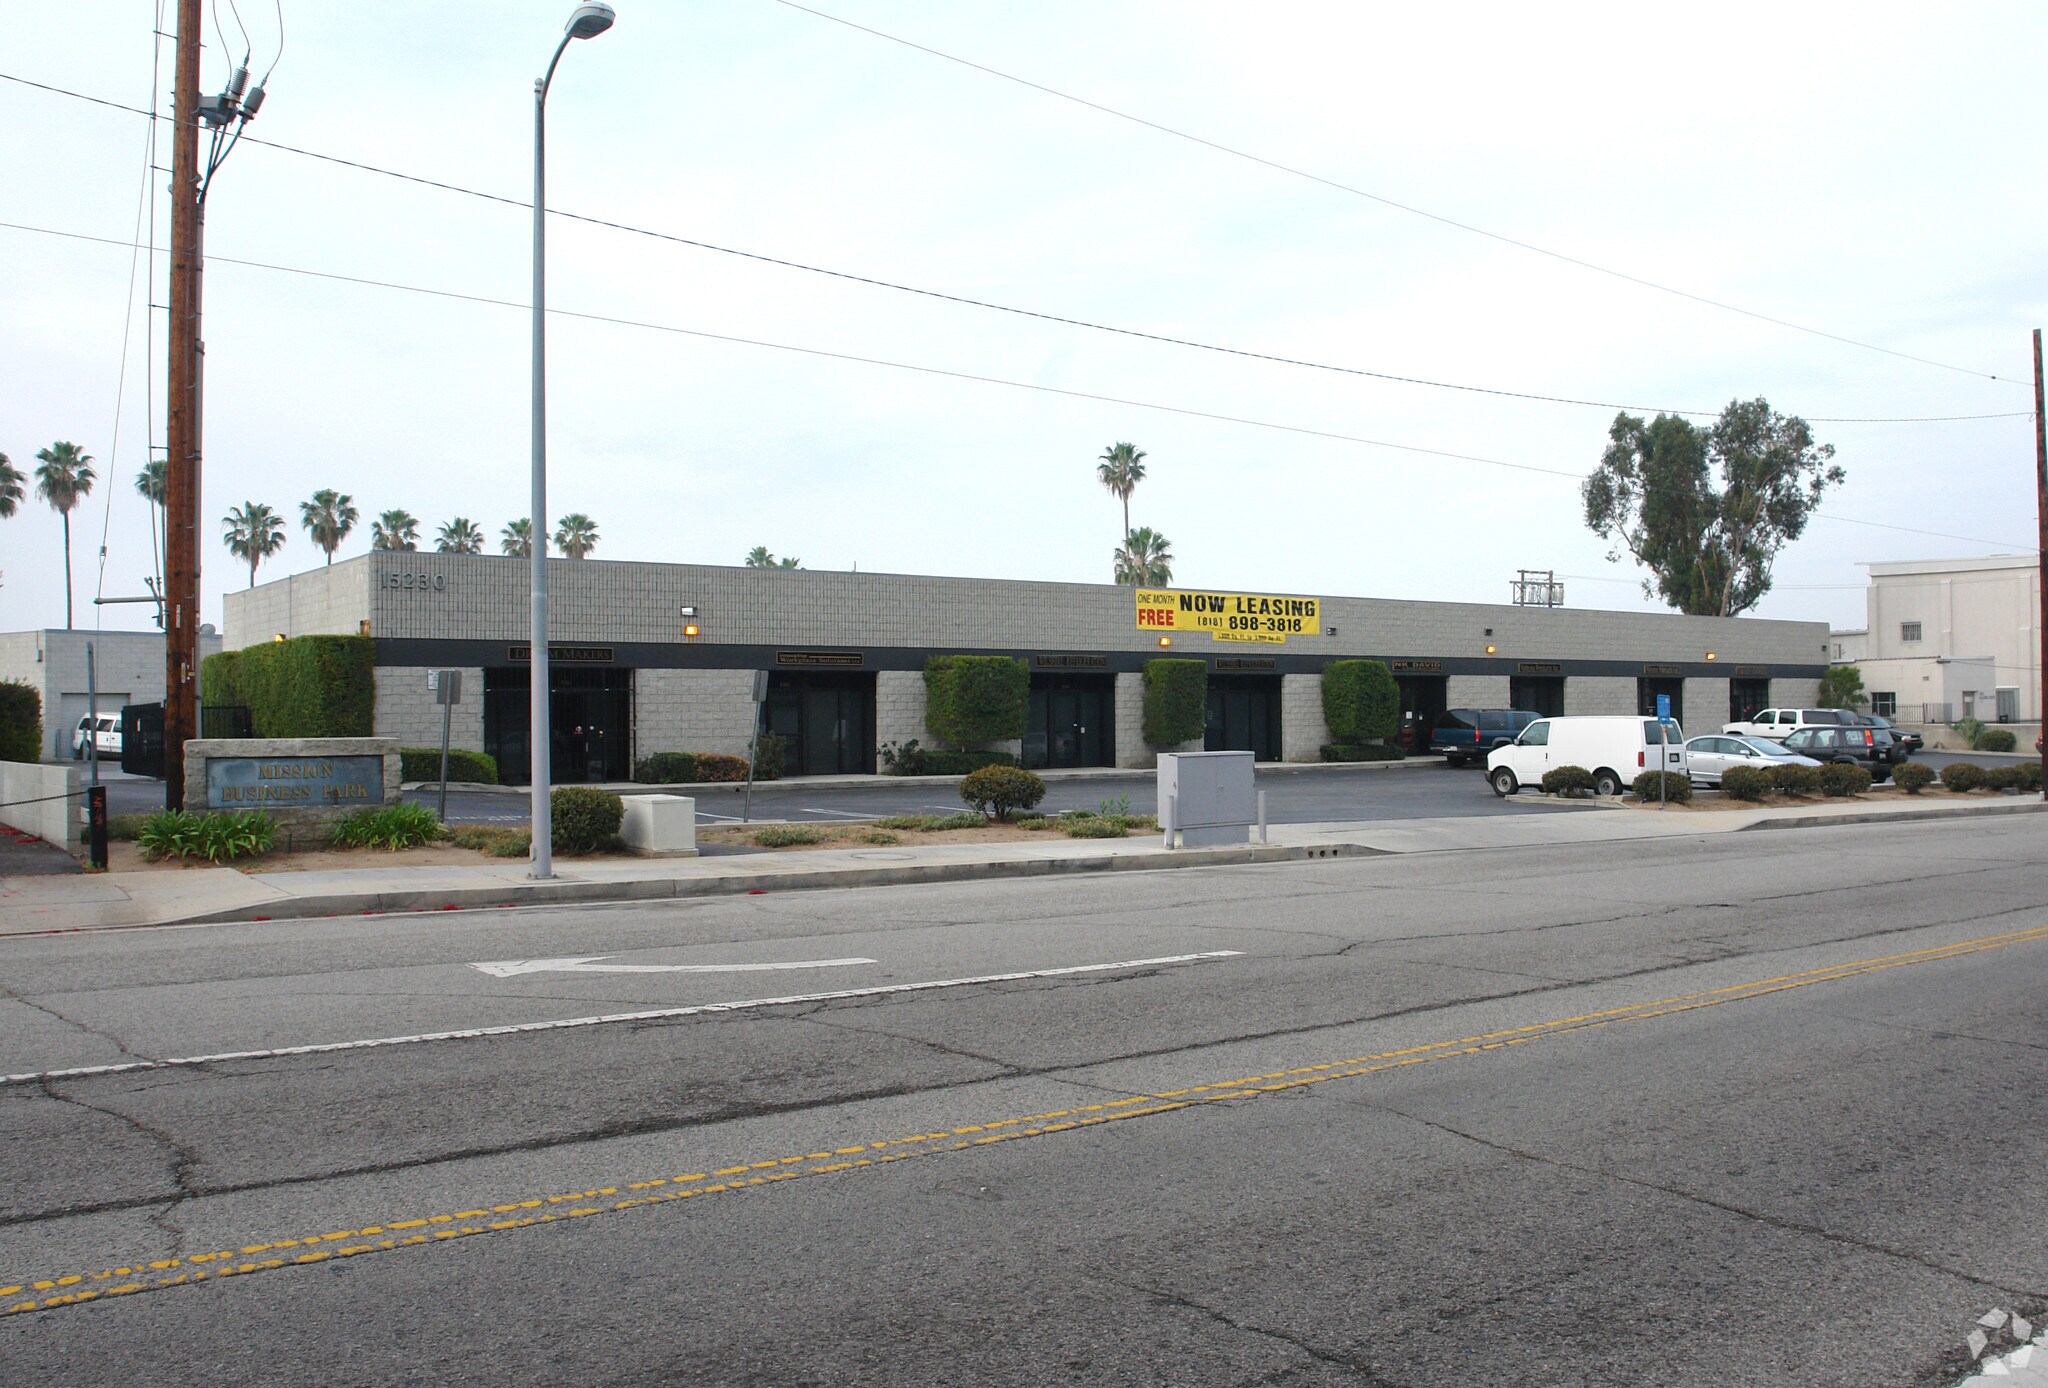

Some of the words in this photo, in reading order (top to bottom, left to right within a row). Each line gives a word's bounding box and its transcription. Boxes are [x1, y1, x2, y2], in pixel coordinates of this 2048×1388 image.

[381, 573, 446, 591] 15230
[1138, 594, 1152, 604] ONE
[1153, 594, 1175, 605] MONTH
[1179, 594, 1226, 613] NOW
[1236, 597, 1316, 617] LEASING
[1138, 608, 1175, 626] FREE
[1197, 616, 1223, 627] (818)
[1229, 616, 1302, 632] 898-3818
[515, 648, 558, 659] DRM
[562, 648, 610, 660] MAKERS
[257, 763, 334, 780] MISSION
[221, 784, 313, 802] BUSINESS
[322, 783, 368, 800] PARK
